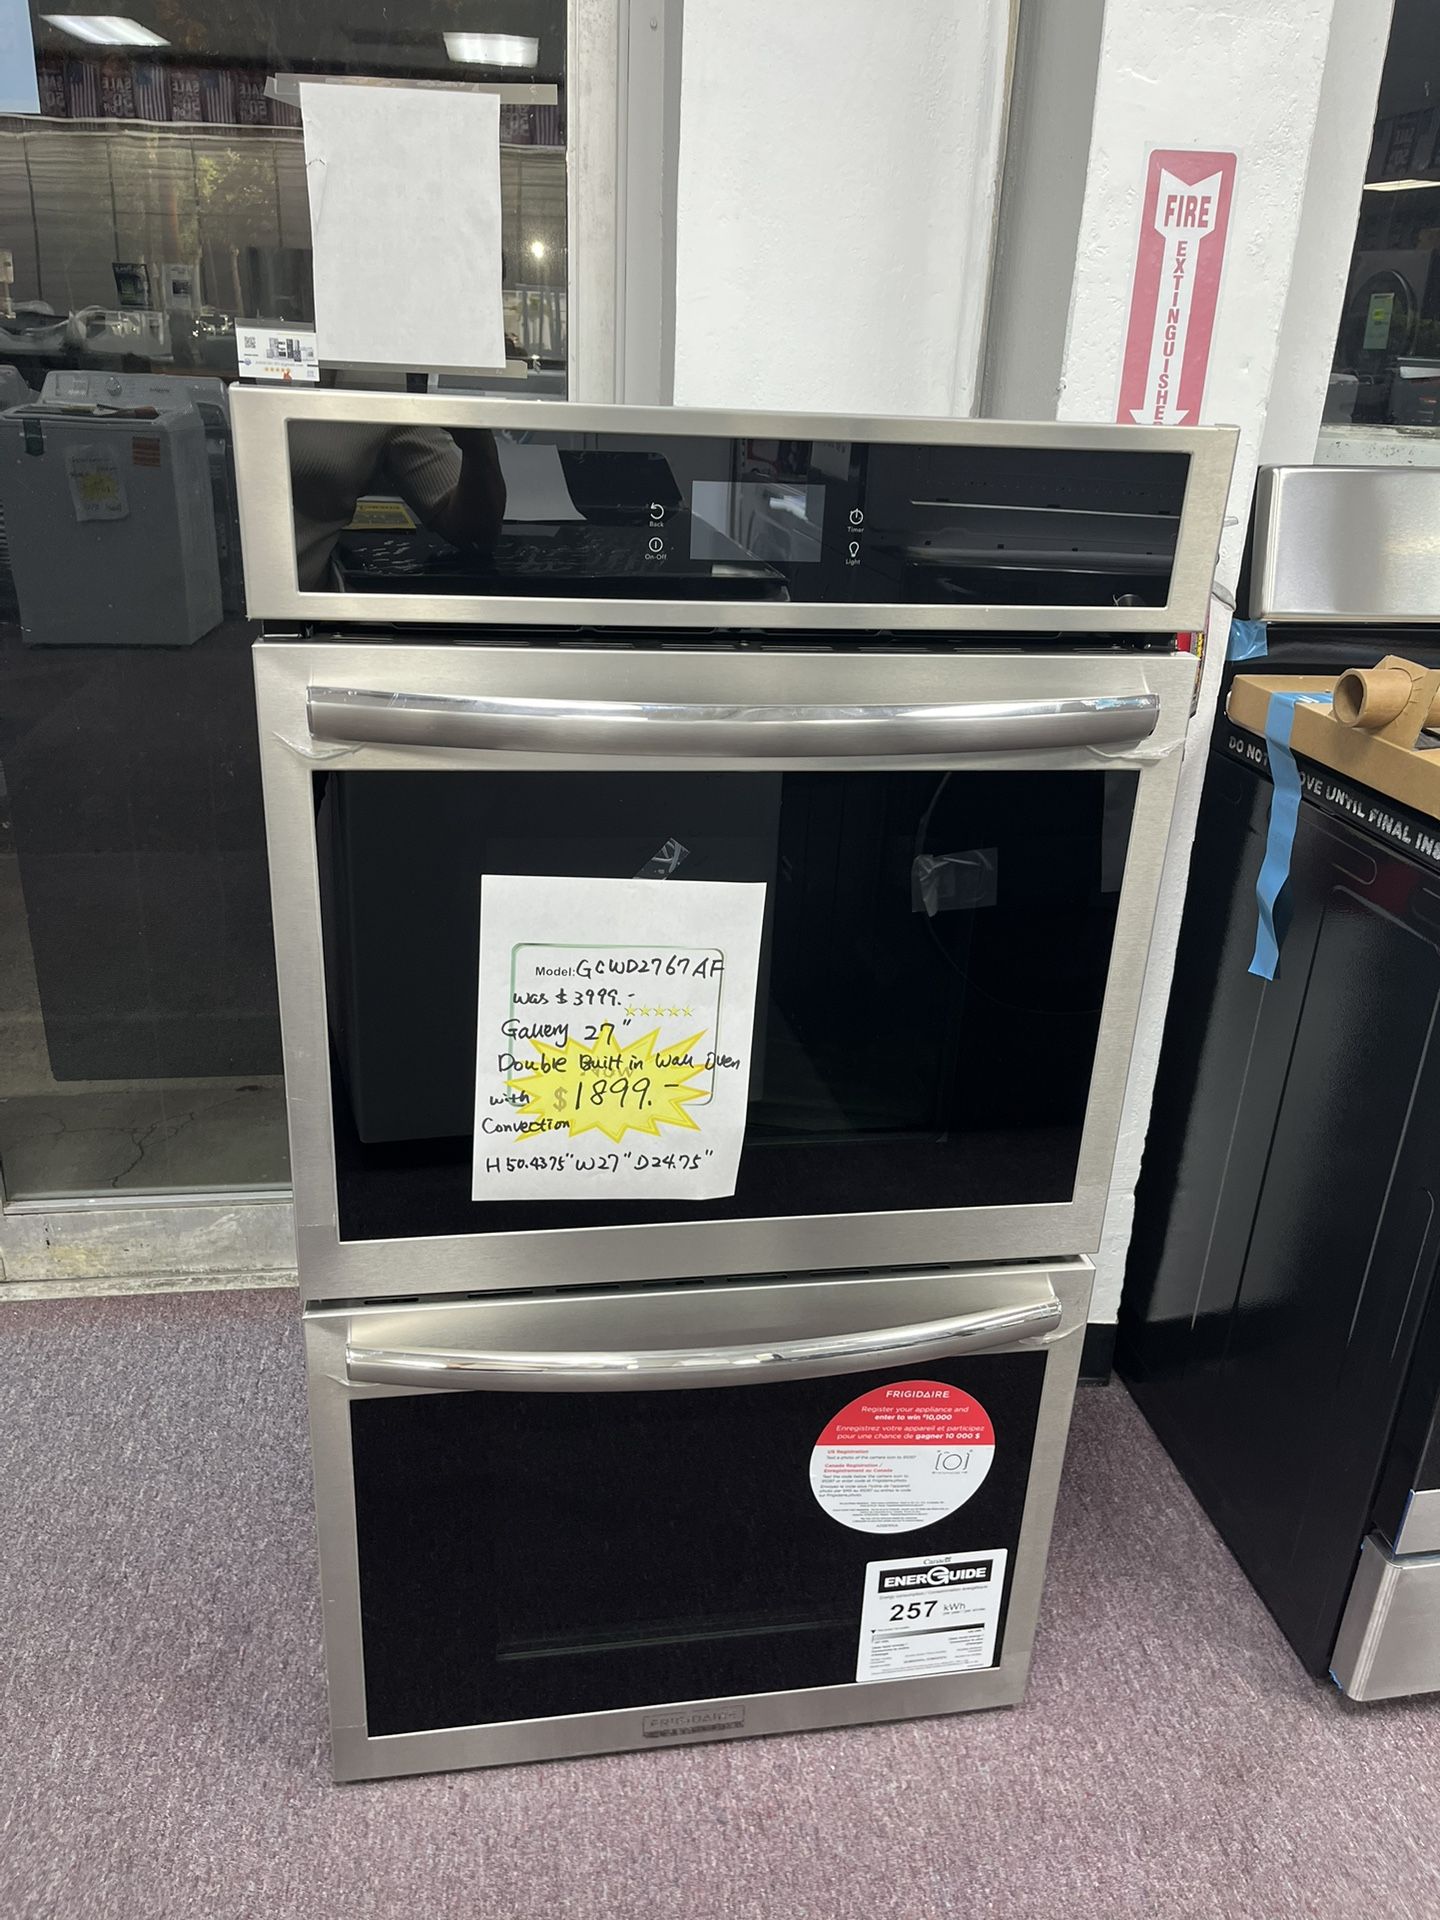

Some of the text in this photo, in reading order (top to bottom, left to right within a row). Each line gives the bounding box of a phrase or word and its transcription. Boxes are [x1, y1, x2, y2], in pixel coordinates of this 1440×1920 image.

[1164, 194, 1212, 228] FIRE
[1153, 240, 1188, 424] EXTINGUISHE
[1229, 736, 1244, 753] DO
[1325, 785, 1365, 819] UNTIL
[1368, 808, 1411, 845] FINAL
[534, 966, 575, 977] Model:
[885, 1389, 951, 1399] FRIGIDAIRE
[861, 1405, 970, 1414] Register your appliance and
[835, 1424, 881, 1433] Enregistrez
[904, 1424, 936, 1433] appareil
[946, 1424, 985, 1433] participez
[836, 1433, 856, 1441] pour
[915, 1432, 944, 1441] gagner
[889, 1600, 938, 1621] 257
[943, 1602, 966, 1611] kWh
